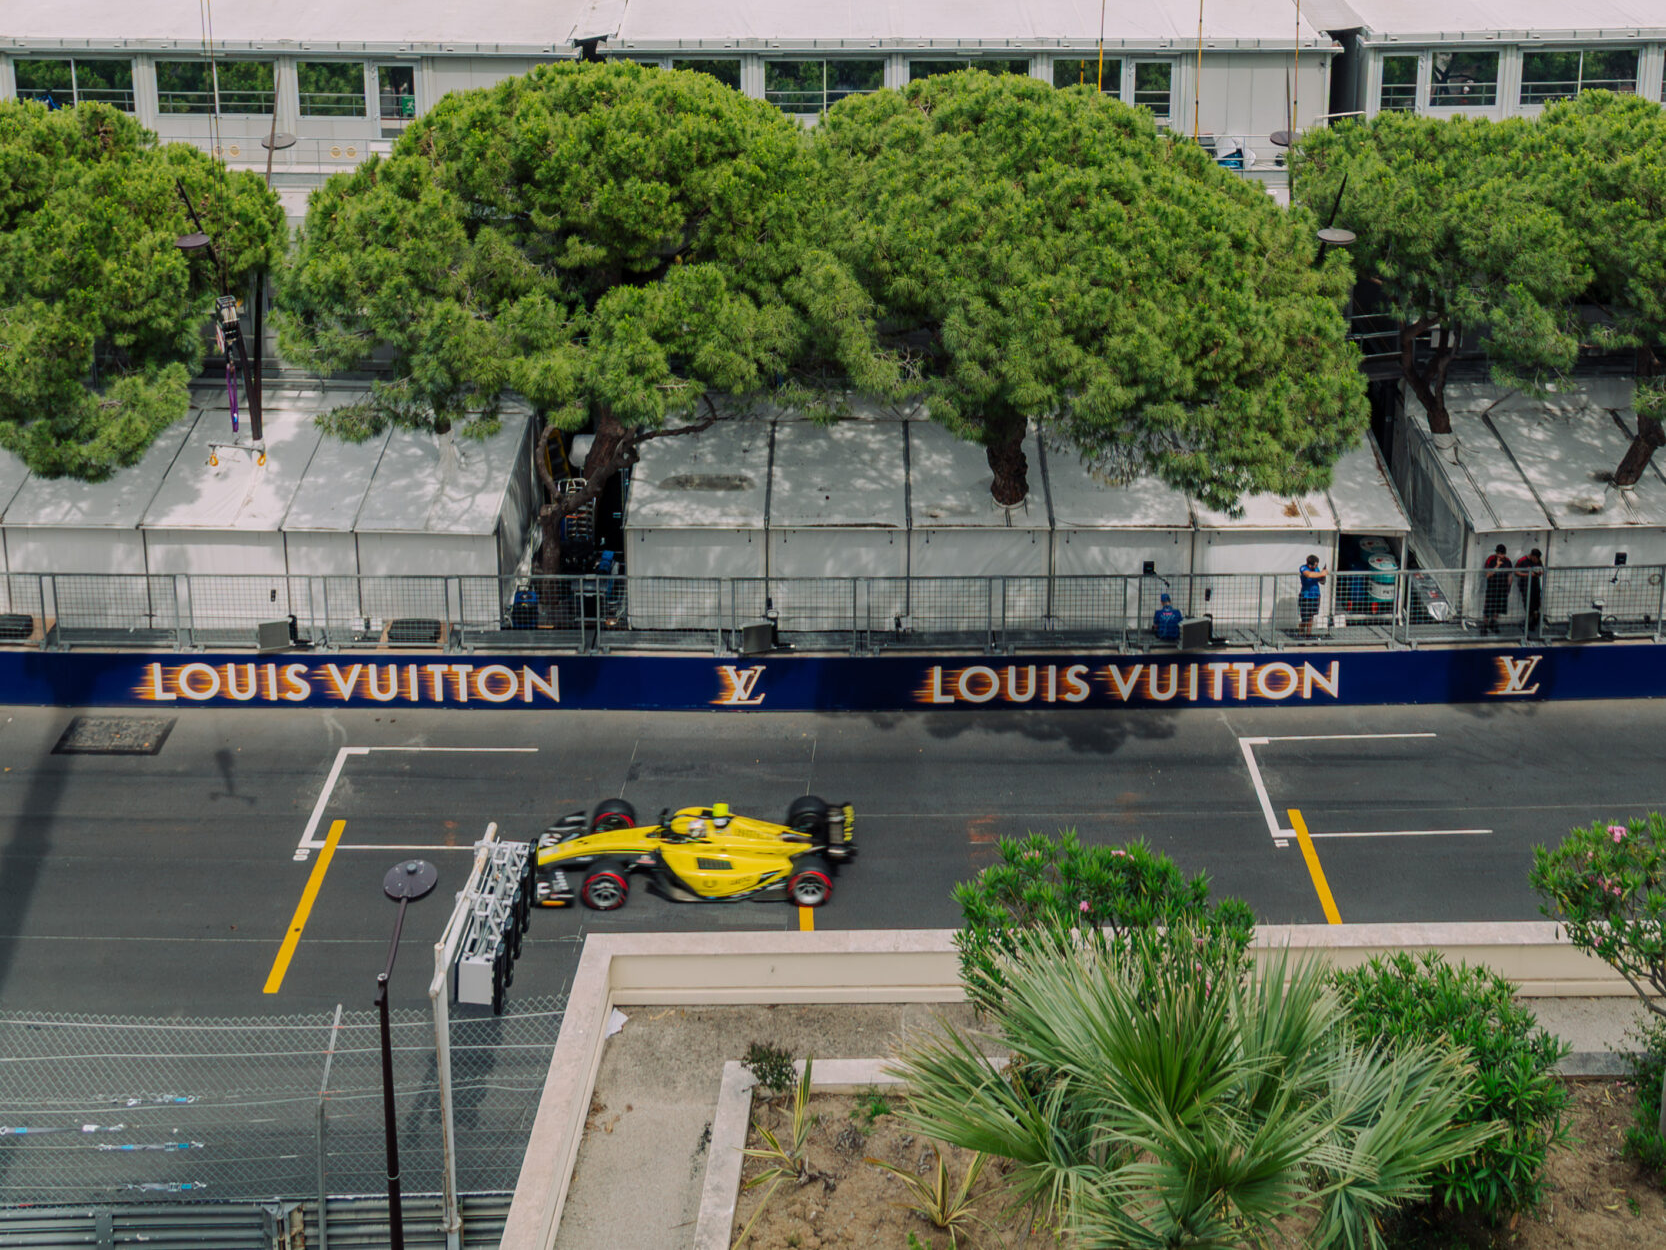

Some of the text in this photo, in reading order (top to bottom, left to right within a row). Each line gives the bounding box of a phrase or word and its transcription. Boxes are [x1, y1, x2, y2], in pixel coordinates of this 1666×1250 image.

[152, 662, 561, 703] LOUIS VUITTON
[932, 661, 1340, 704] LOUIS VUITTON
